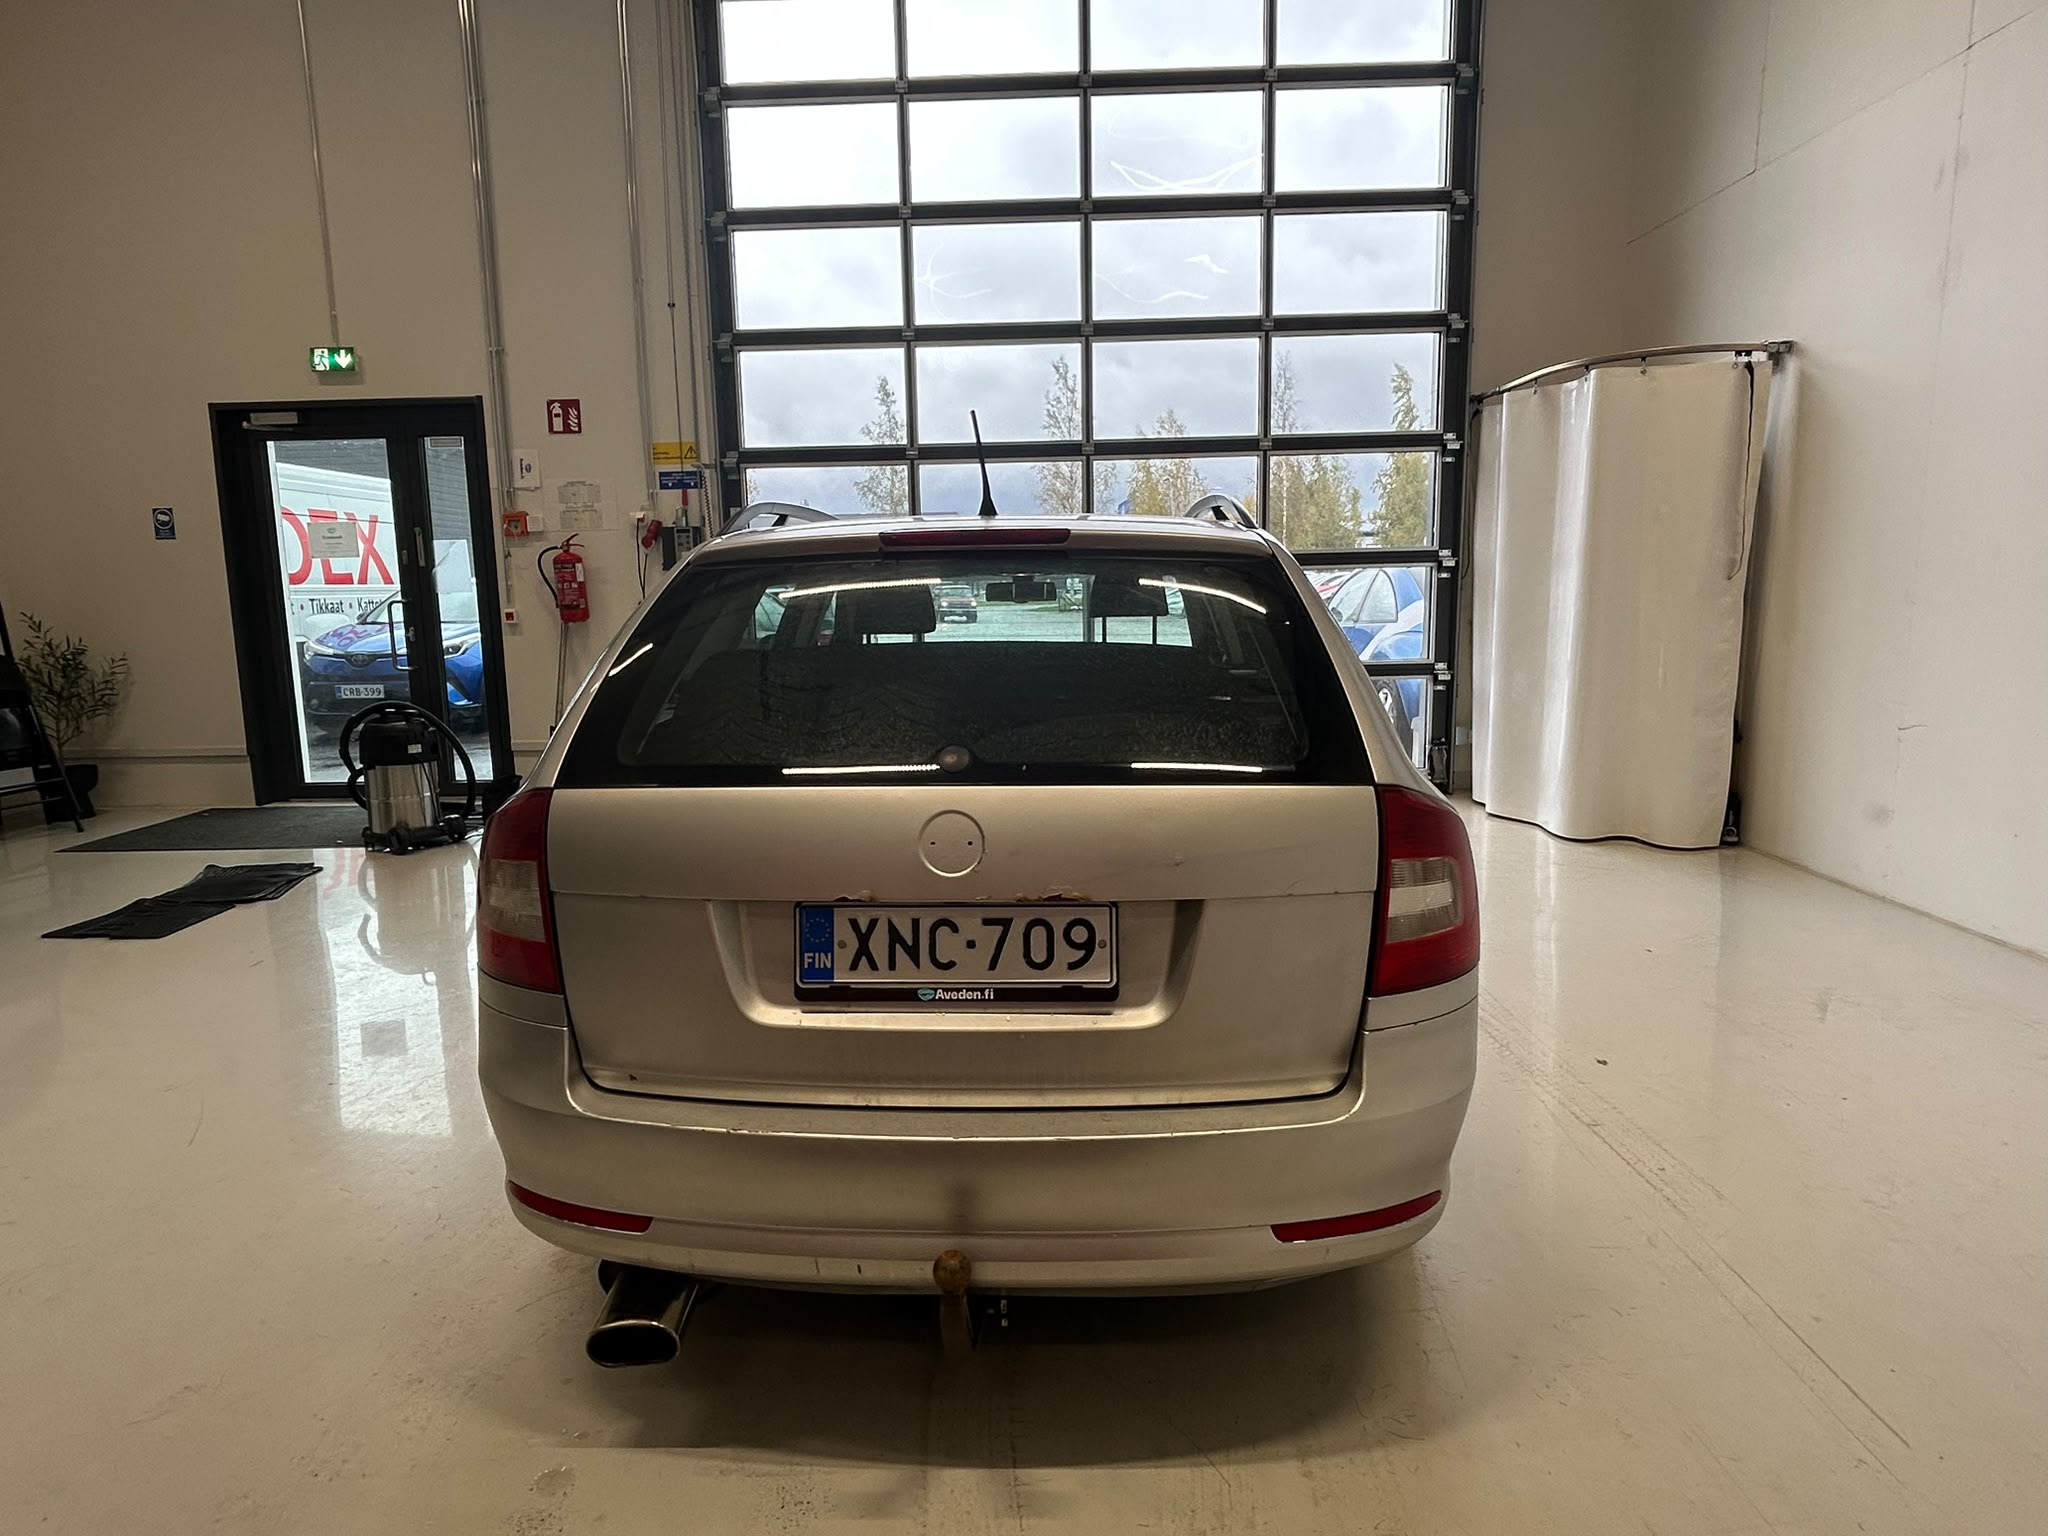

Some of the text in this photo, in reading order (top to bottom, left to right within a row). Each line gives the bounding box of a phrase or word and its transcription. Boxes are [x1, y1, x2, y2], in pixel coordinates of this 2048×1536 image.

[309, 599, 344, 614] Tikkaat
[356, 598, 382, 612] Katto
[804, 952, 832, 968] FIN
[935, 988, 994, 1000] Aveden.fi
